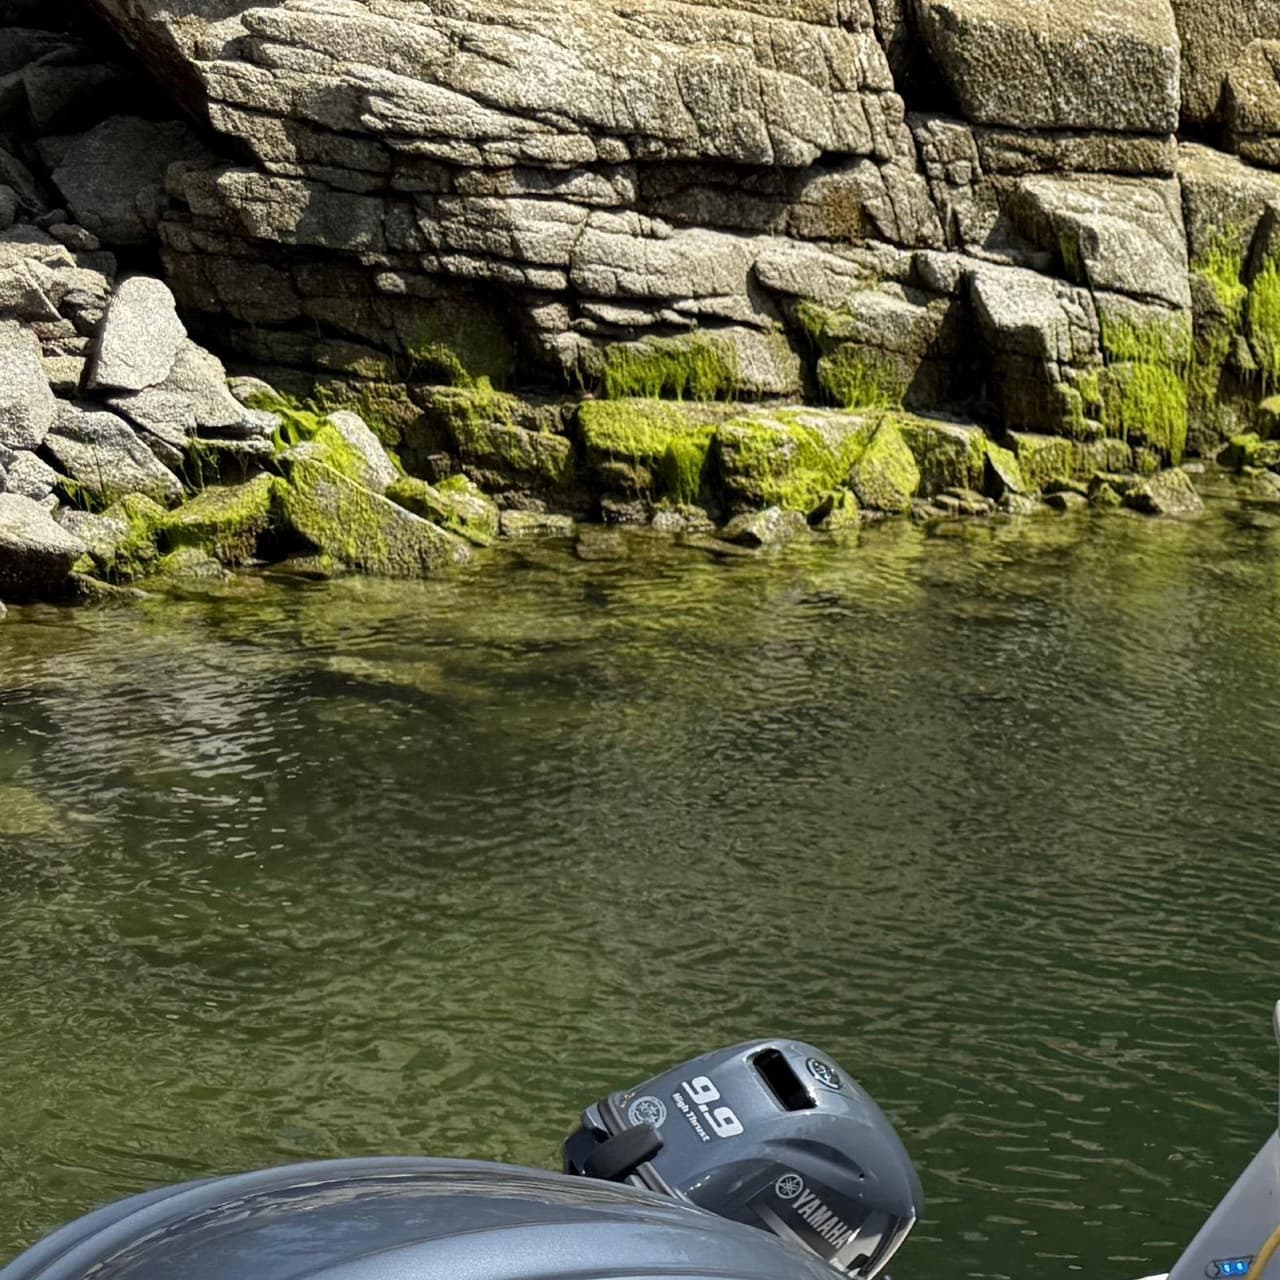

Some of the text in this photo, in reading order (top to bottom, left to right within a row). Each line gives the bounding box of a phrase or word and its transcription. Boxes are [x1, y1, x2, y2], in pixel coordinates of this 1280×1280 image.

[672, 1092, 711, 1142] High Thrust
[682, 1076, 744, 1137] 9.9
[790, 1188, 852, 1249] YAMAHA
